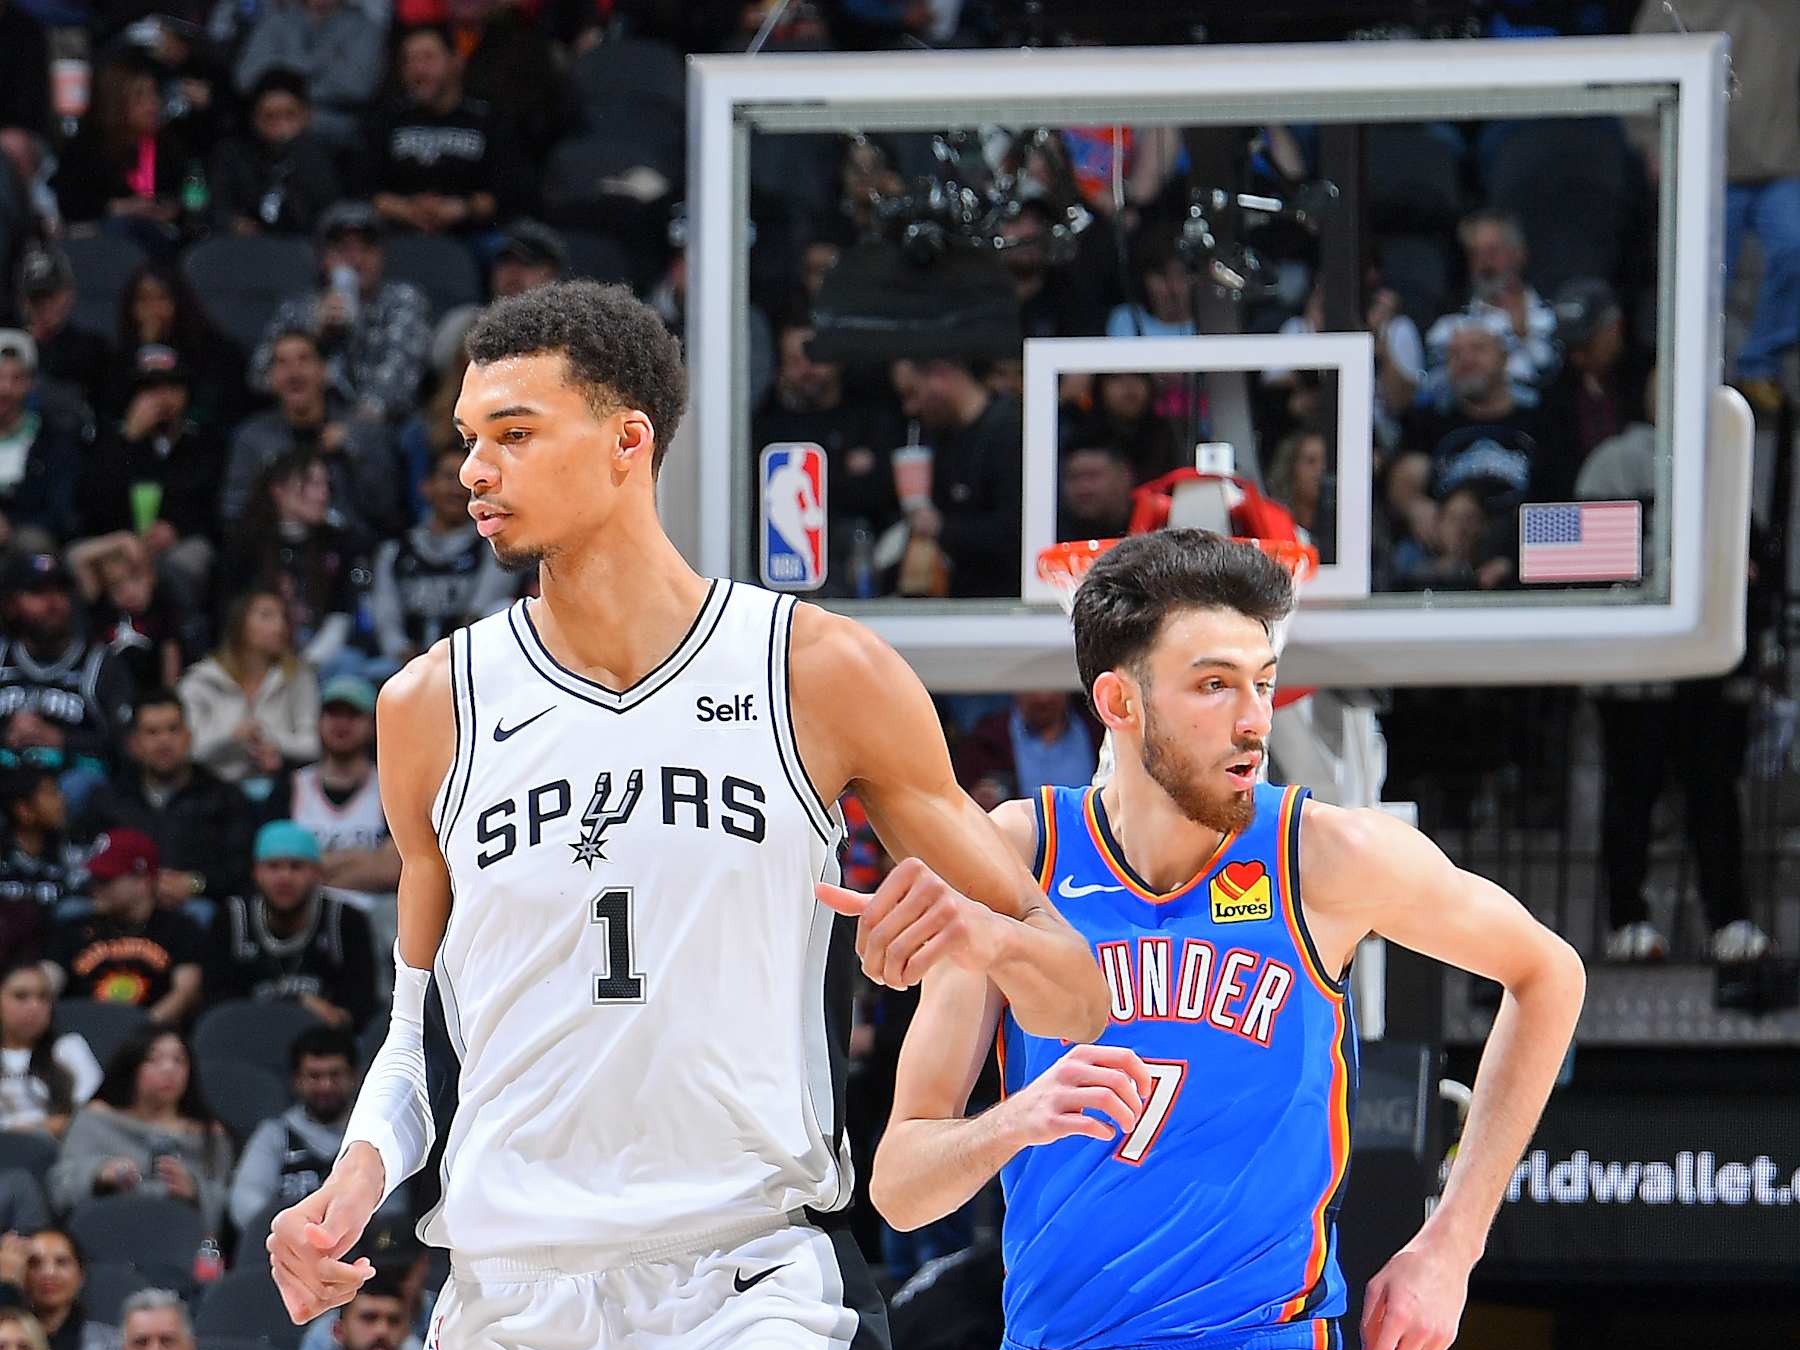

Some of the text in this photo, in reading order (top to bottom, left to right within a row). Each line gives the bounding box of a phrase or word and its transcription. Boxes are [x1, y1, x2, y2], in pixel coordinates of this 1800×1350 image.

[696, 694, 758, 722] Self.
[477, 767, 766, 871] SPURS
[591, 886, 647, 1005] 1
[1097, 937, 1292, 1048] UNDER
[1112, 1058, 1188, 1167] 7
[1358, 1097, 1411, 1133] NG
[1504, 1150, 1800, 1204] rldwallet.
